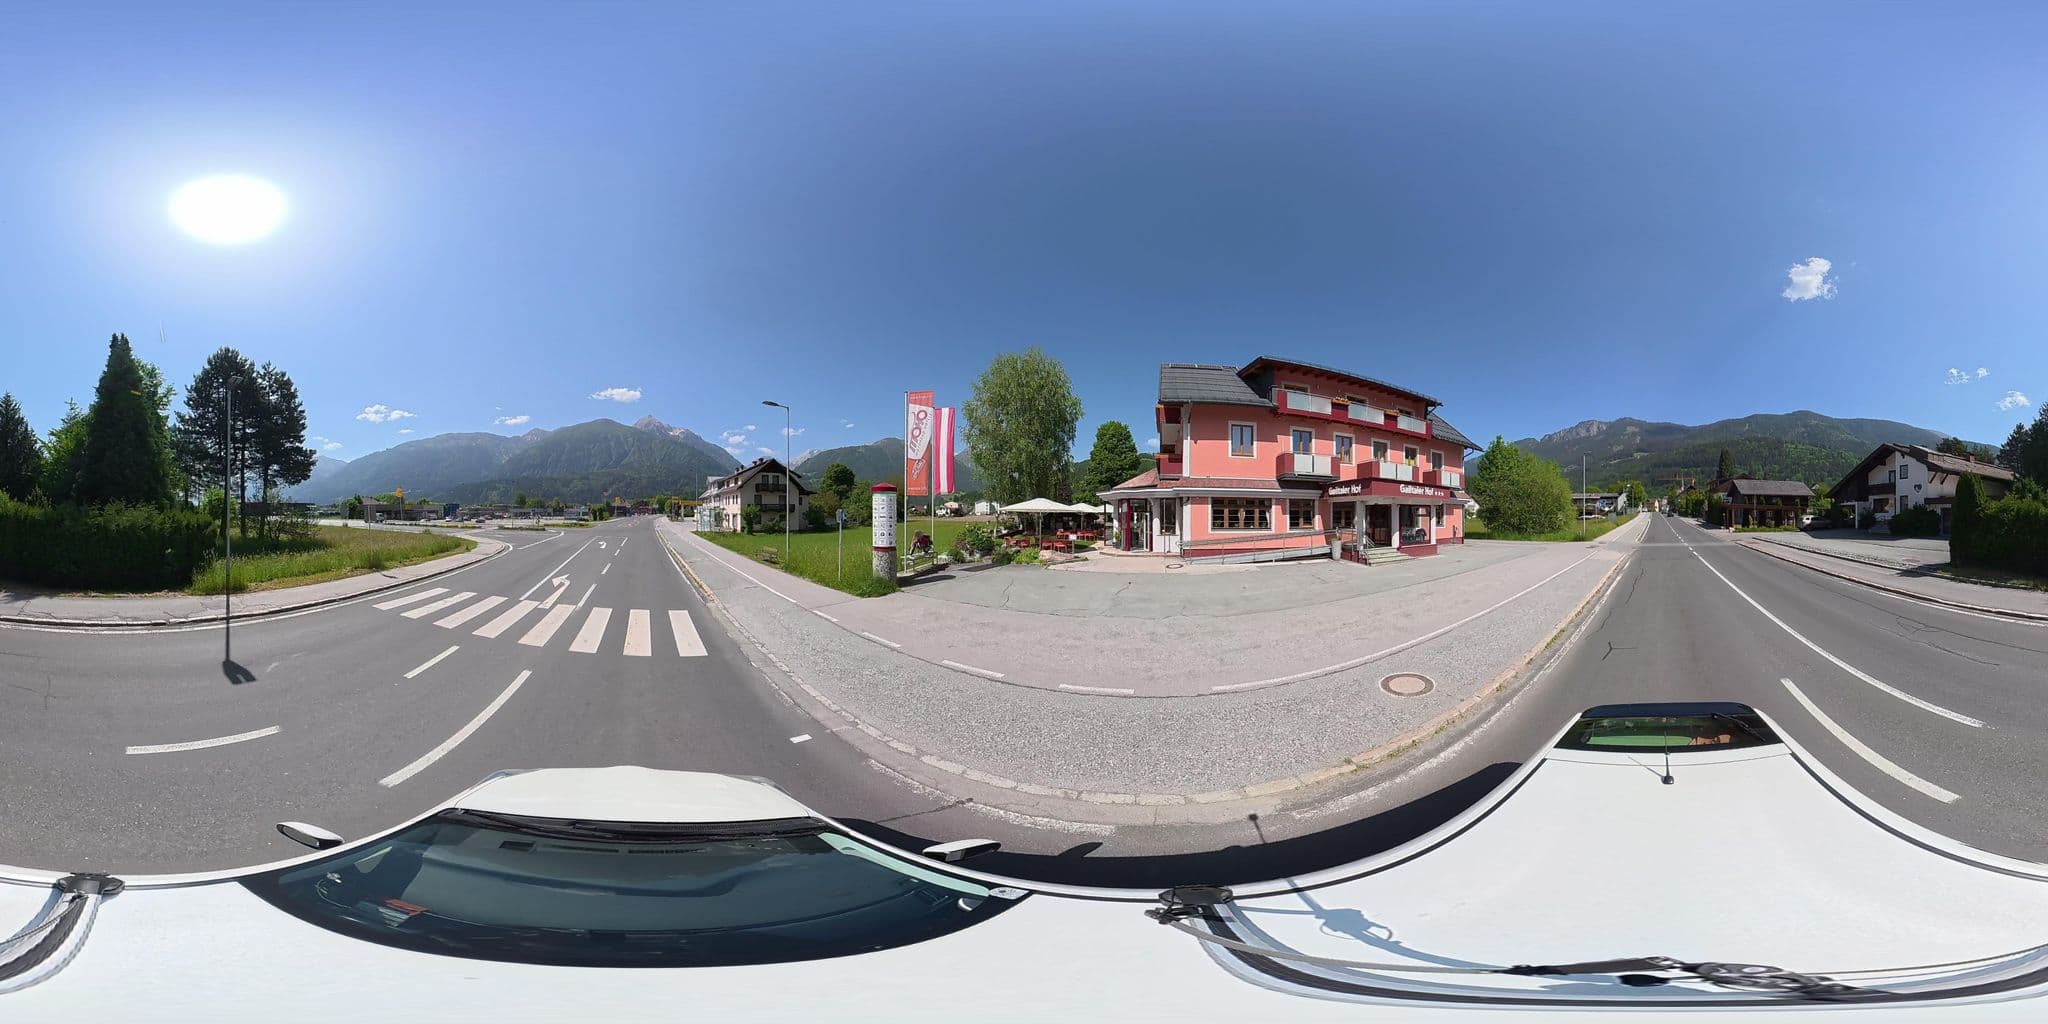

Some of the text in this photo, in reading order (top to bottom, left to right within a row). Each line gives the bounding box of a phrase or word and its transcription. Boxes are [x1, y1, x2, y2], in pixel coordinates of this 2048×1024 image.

[1328, 484, 1362, 496] Gailtaler Hof
[1399, 484, 1434, 496] Gailtaler Hof
